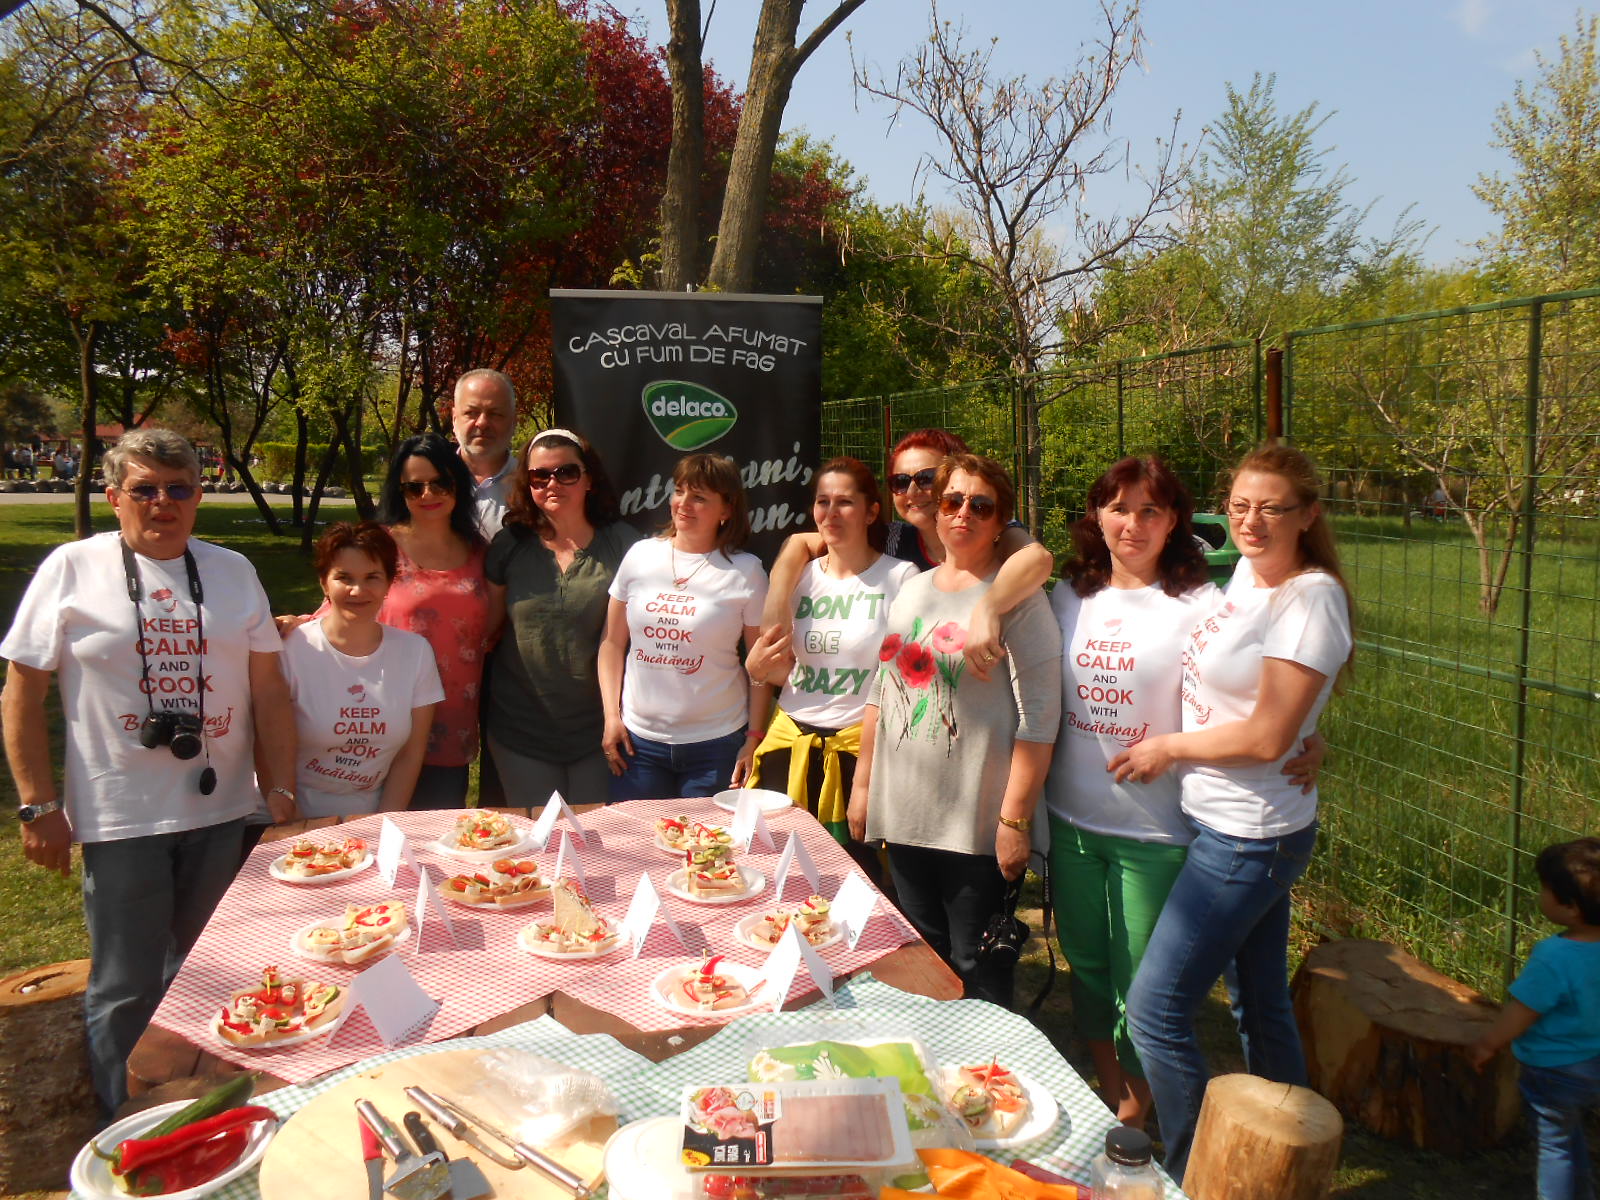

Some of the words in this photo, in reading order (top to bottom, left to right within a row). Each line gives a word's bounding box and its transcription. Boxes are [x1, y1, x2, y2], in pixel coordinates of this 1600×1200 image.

[600, 350, 630, 369] CU
[690, 346, 726, 365] DE
[651, 395, 727, 417] delaco
[656, 592, 695, 603] KEEP
[645, 602, 696, 616] CALM
[795, 591, 885, 620] DON'T
[143, 618, 200, 634] KEEP
[657, 617, 679, 625] AND
[643, 626, 693, 643] COOK
[135, 638, 209, 656] CALM
[655, 642, 679, 651] WITH
[805, 630, 841, 654] BE
[1085, 639, 1132, 653] KEEP
[159, 661, 190, 672] AND
[1076, 653, 1135, 672] CALM
[139, 675, 214, 695] COOK
[1092, 674, 1118, 684] AND
[1077, 684, 1134, 705] COOK
[161, 698, 198, 709] WITH
[340, 707, 380, 718] KEEP
[1089, 705, 1118, 718] WITH
[333, 722, 386, 735] CALM
[335, 755, 361, 767] WITH
